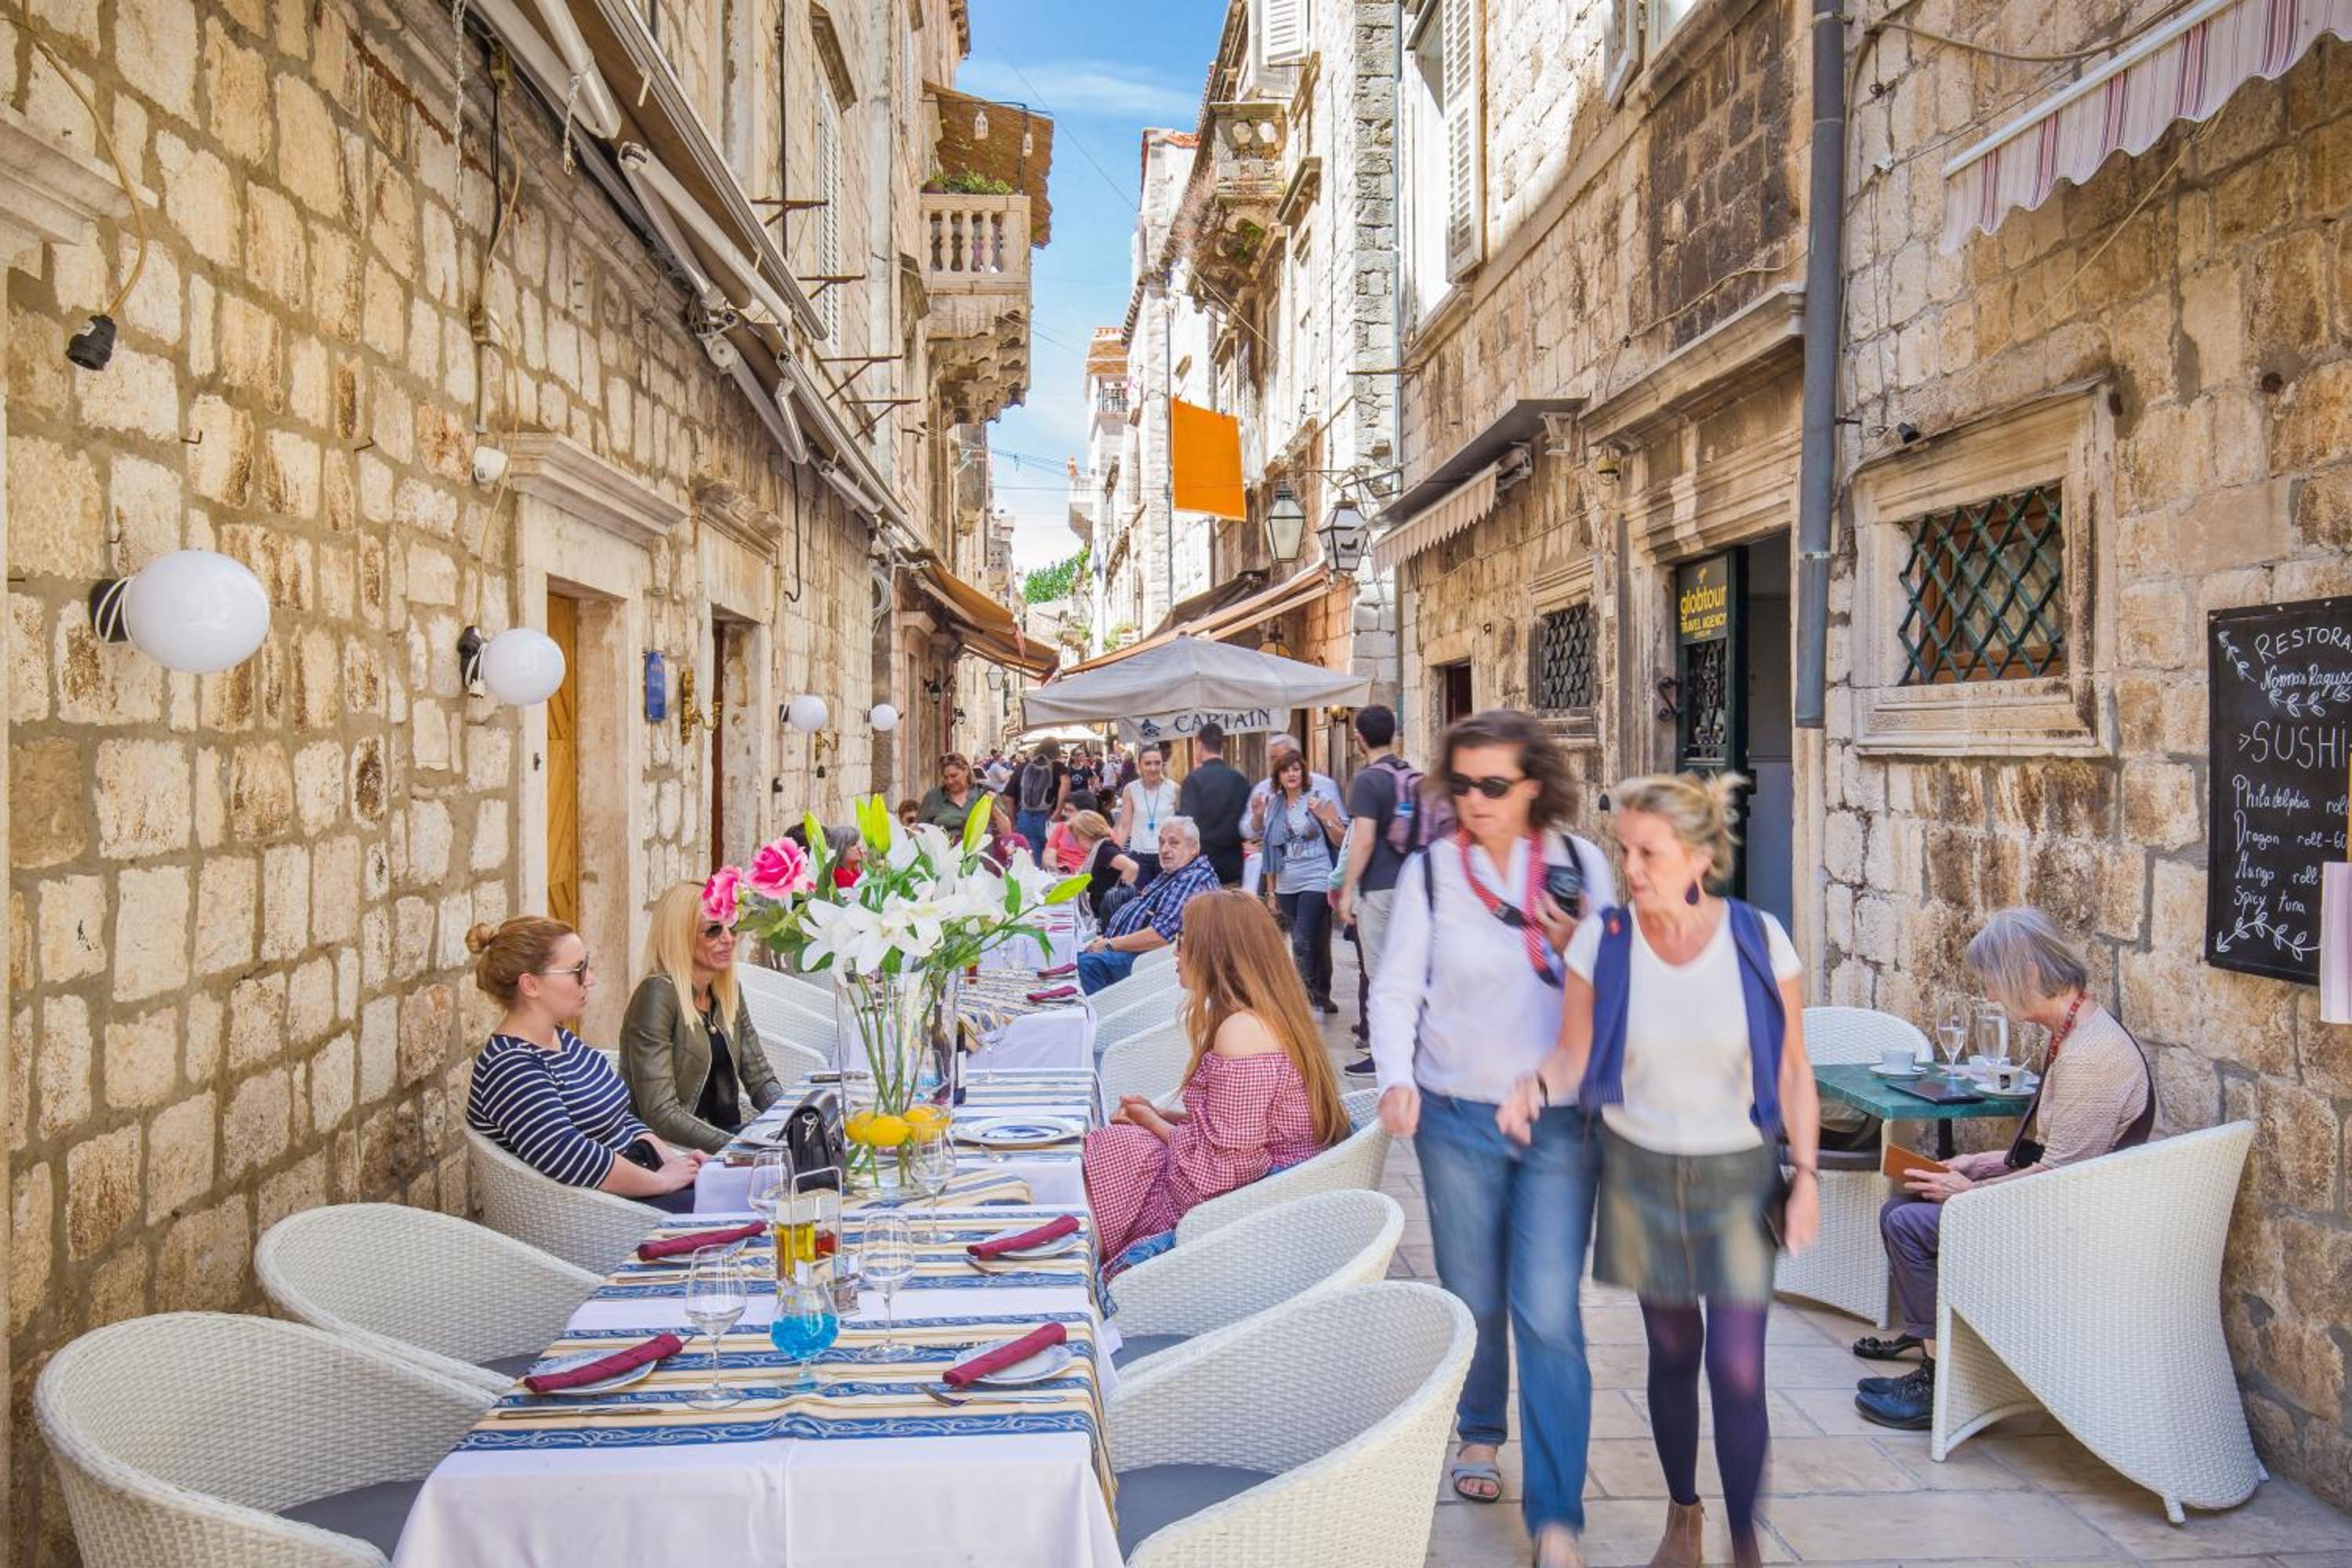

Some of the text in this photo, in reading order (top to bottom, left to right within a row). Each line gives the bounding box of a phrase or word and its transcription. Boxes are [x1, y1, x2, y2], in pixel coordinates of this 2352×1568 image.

[1680, 585, 1727, 621] globtour
[1680, 612, 1727, 634] TRAVEL AGENCY
[2255, 626, 2352, 664] RESTORA
[1174, 707, 1270, 733] CAPTAIN
[2232, 774, 2309, 816] Philadelphia
[2234, 809, 2280, 851] Dragon
[2235, 849, 2274, 887] Mango
[2234, 885, 2306, 916] Spicy tuna
